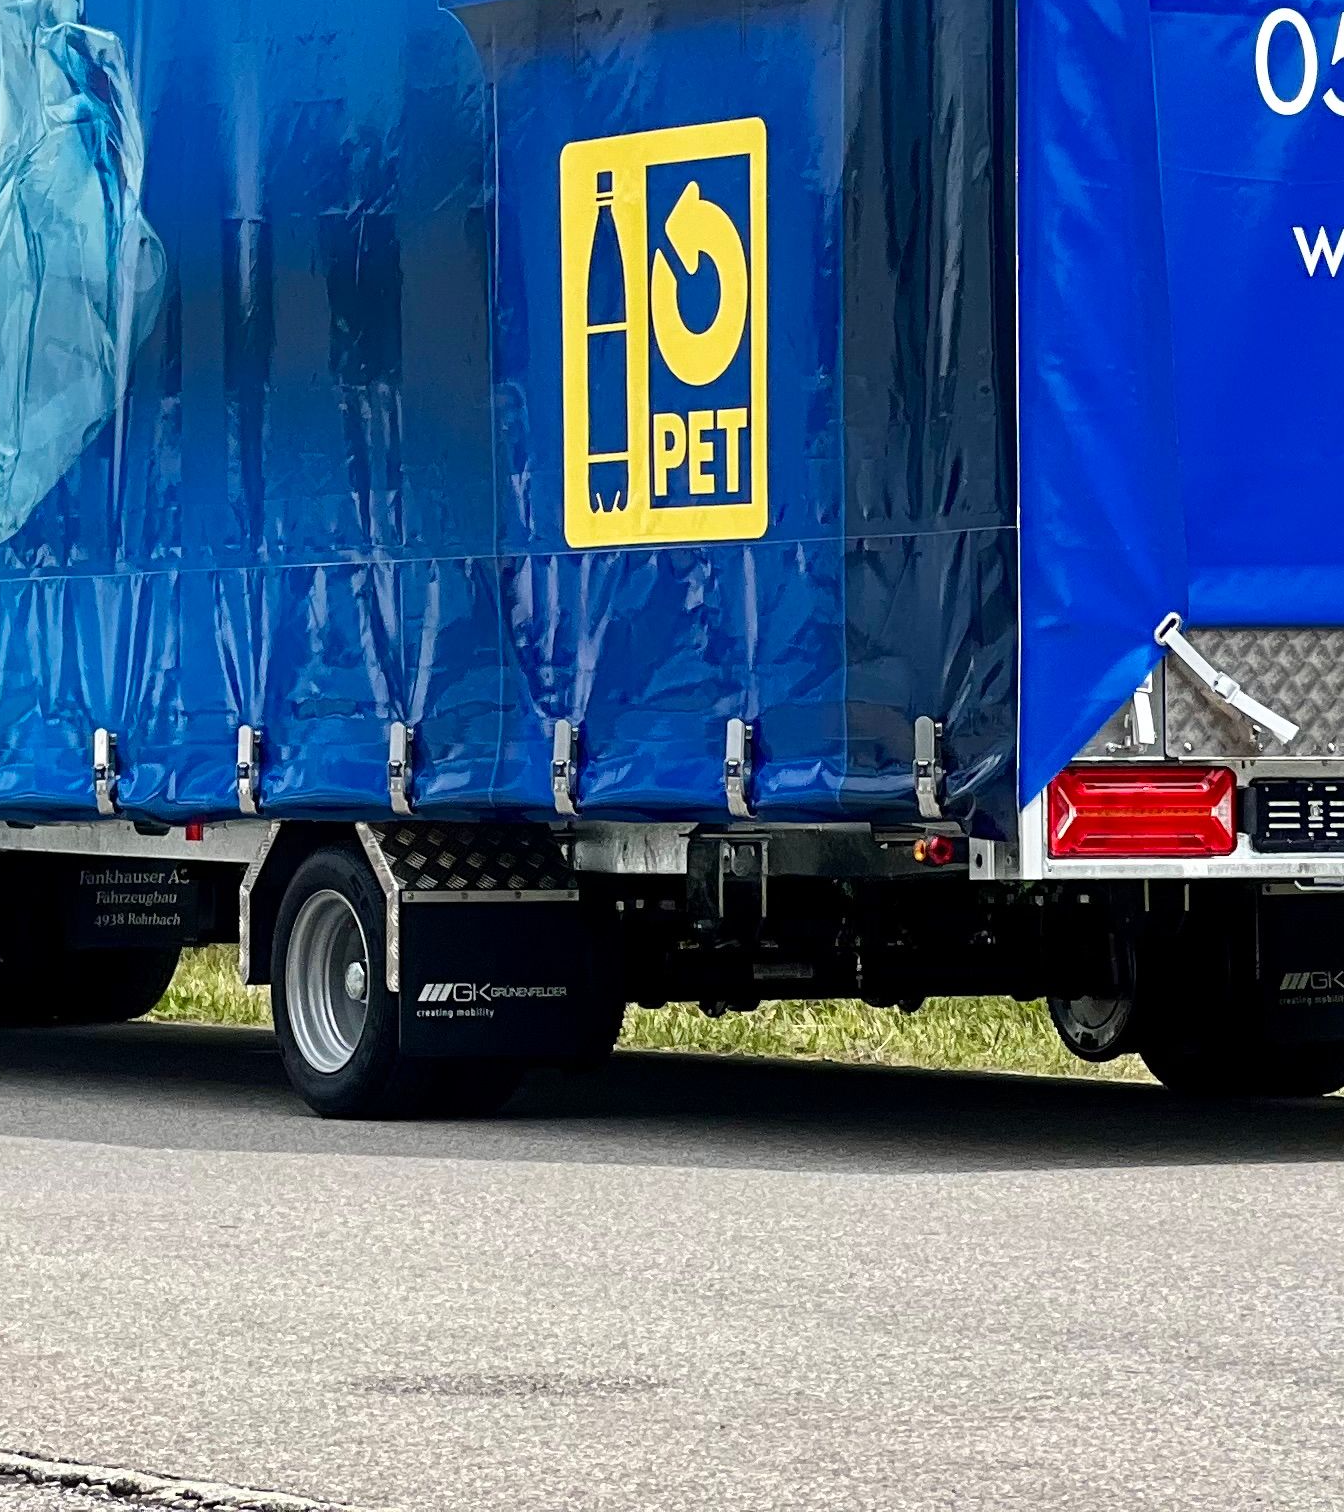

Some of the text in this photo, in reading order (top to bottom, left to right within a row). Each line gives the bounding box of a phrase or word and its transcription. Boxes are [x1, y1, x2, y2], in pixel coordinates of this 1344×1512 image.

[653, 407, 748, 496] PET
[79, 868, 166, 886] Fankhauser
[96, 890, 178, 907] Fahrzeugbau
[95, 912, 181, 927] 4938 Rohrbach
[453, 982, 492, 1002] GK
[416, 1007, 495, 1019] creating mobility
